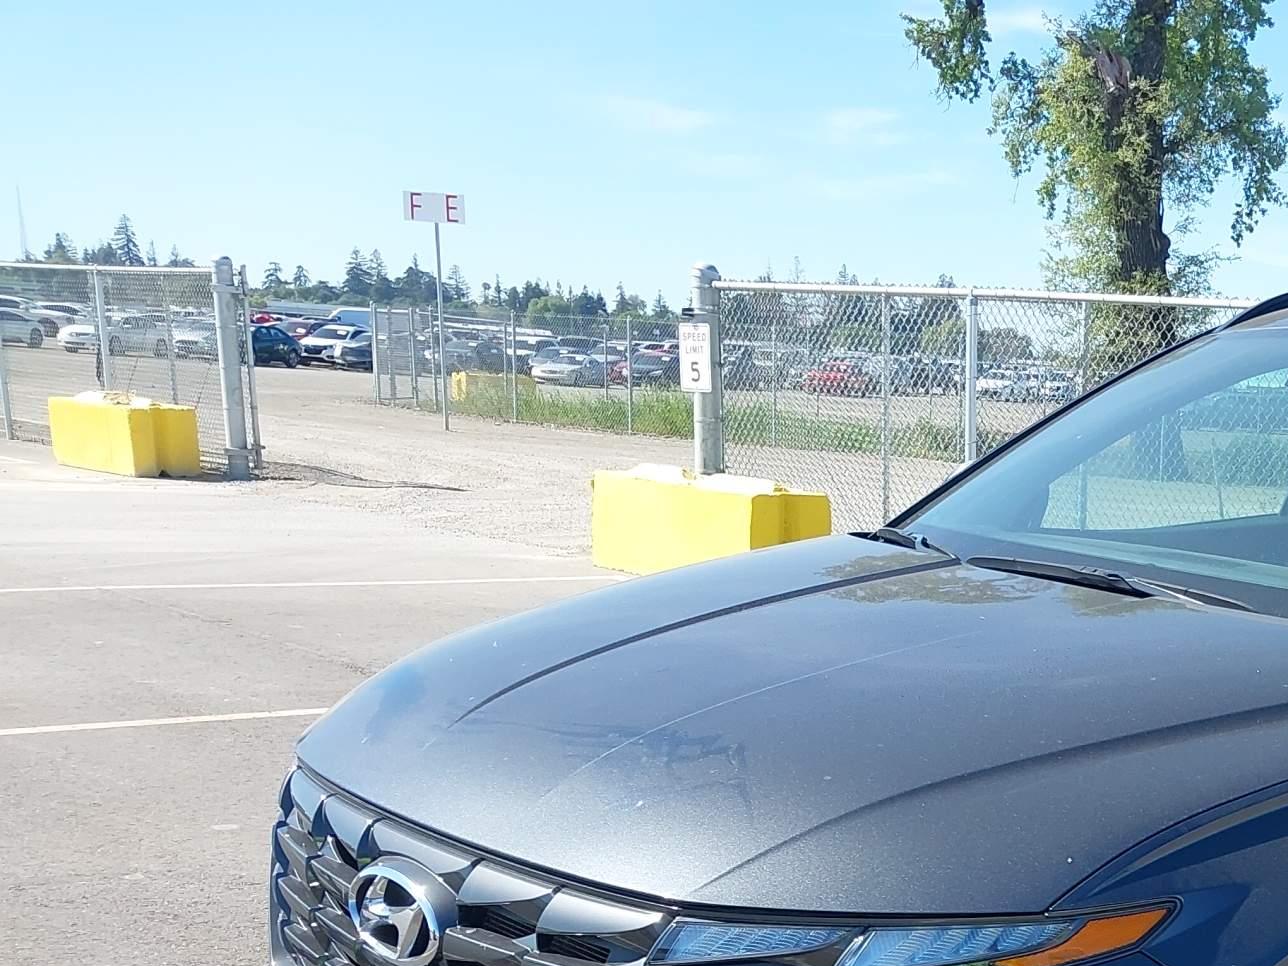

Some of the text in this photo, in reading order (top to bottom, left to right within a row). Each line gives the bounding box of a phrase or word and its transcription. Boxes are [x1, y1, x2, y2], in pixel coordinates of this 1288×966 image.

[410, 192, 459, 223] F E
[682, 332, 706, 342] SPEED
[685, 345, 704, 354] LIMIT
[691, 361, 701, 383] 5
